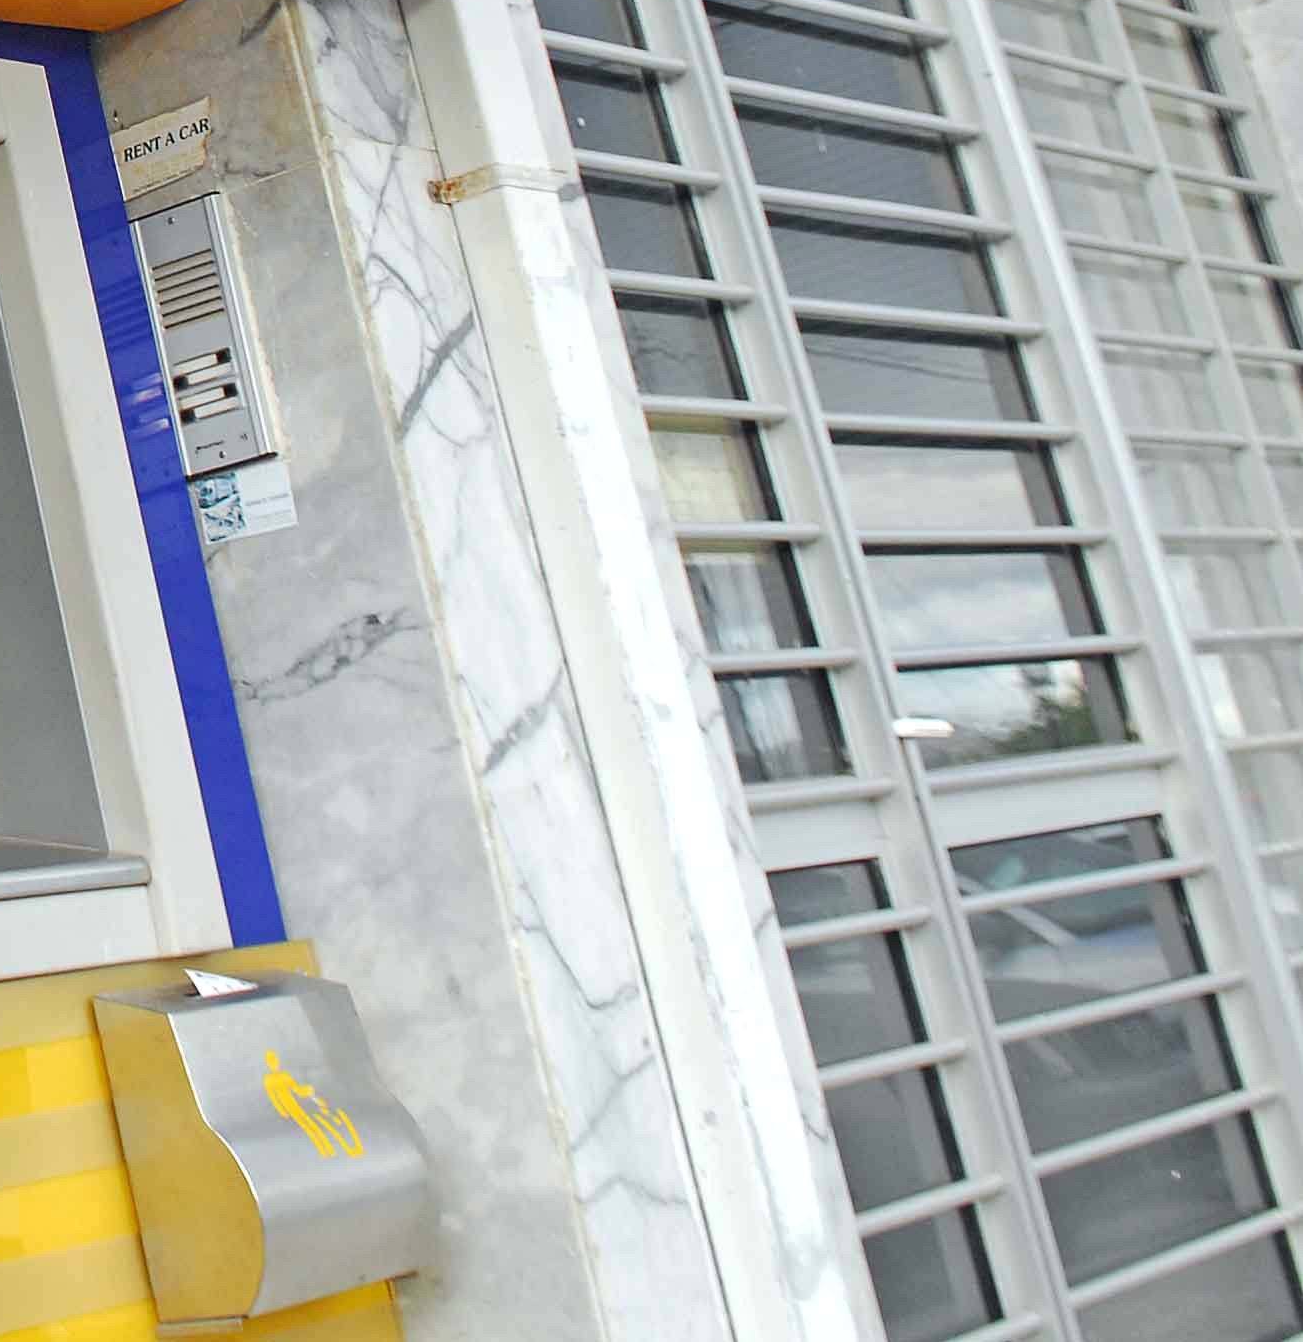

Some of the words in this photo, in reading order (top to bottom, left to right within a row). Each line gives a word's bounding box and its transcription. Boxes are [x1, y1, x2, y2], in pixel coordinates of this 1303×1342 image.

[122, 136, 162, 163] RENT
[164, 131, 176, 147] A
[178, 117, 210, 141] CAR
